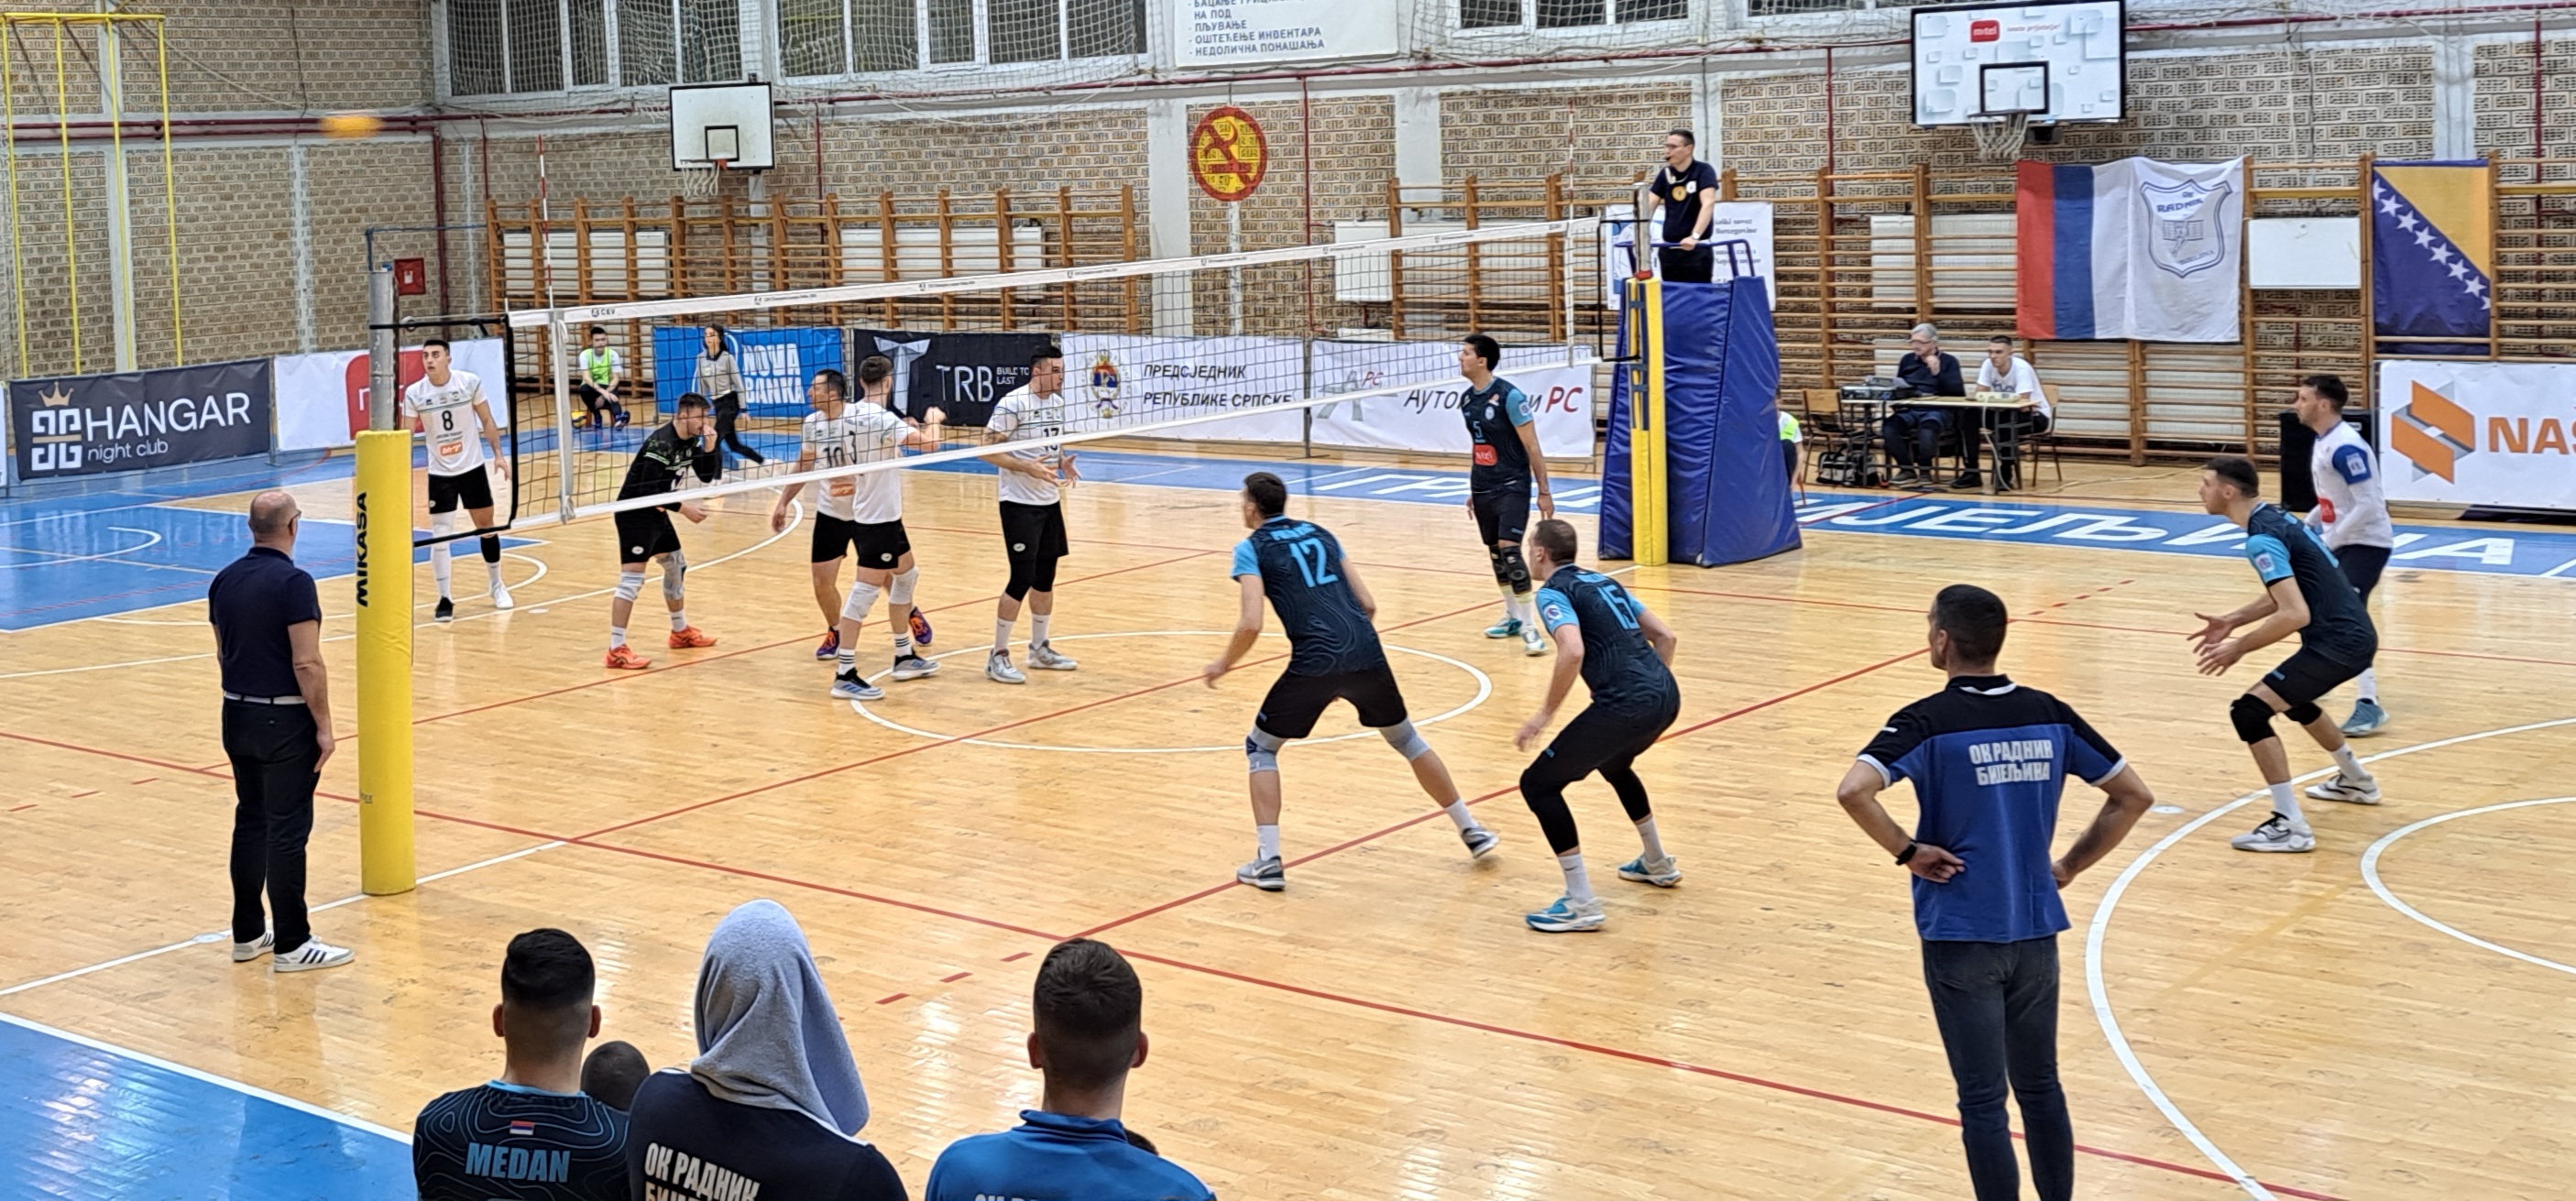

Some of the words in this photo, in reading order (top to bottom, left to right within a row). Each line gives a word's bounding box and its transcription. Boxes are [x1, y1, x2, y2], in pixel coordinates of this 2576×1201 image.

[1194, 11, 1207, 20] НА
[1211, 9, 1233, 19] ПОД
[1195, 20, 1247, 32] ПЉУВАЊЕ
[1195, 32, 1255, 44] ОШТЕЋЕЊЕ
[1258, 27, 1321, 40] ИНВЕНТАРА
[1195, 44, 1258, 57] НЕДОЛИЧНА
[1260, 39, 1324, 53] ПОНАШАЊА
[741, 343, 801, 377] NOVA
[1144, 364, 1247, 381] ПРЕДСЈЕДНИК
[744, 377, 806, 405] BANKA
[936, 365, 994, 402] TRB
[996, 377, 1016, 385] LAST
[1143, 391, 1227, 408] РЕПУБЛИКЕ
[85, 392, 252, 442] HANGAR
[441, 409, 454, 431] 8
[2488, 416, 2576, 455] NA
[88, 442, 132, 464] night
[137, 438, 169, 458] club
[356, 491, 368, 607] MIKASA
[1288, 537, 1339, 588] 12
[1597, 584, 1641, 630] 15
[1968, 744, 1993, 765] ОК
[1991, 739, 2054, 762] РАДНИК
[1975, 761, 2051, 786] БИЈЕЉИНА
[465, 1142, 571, 1183] MEDAN
[644, 1142, 674, 1182] ОК
[672, 1152, 761, 1201] РАДНИК
